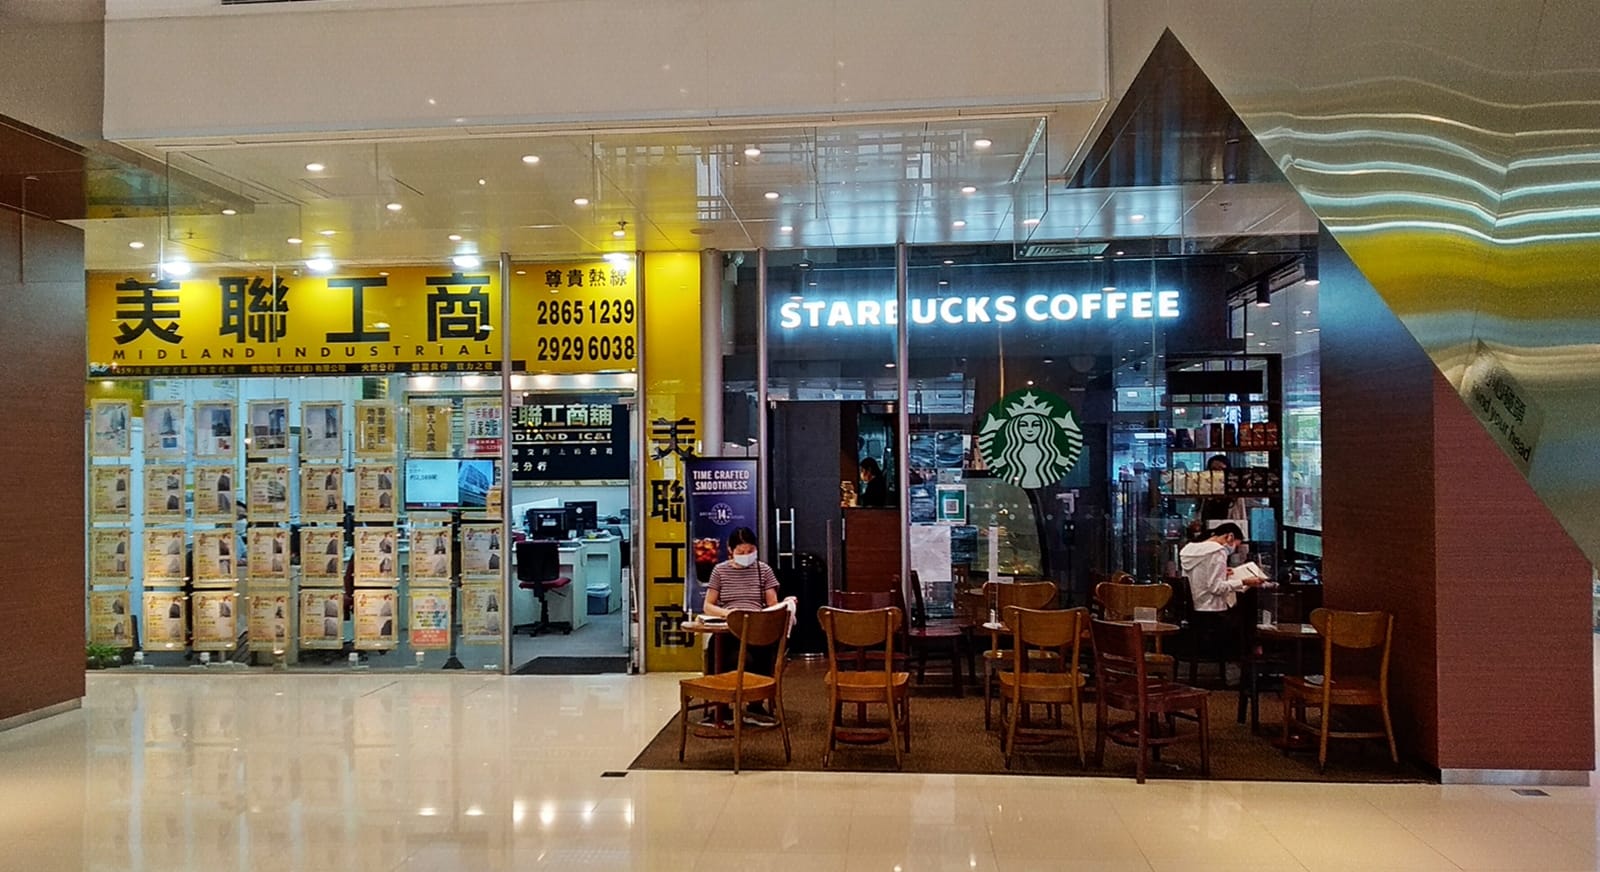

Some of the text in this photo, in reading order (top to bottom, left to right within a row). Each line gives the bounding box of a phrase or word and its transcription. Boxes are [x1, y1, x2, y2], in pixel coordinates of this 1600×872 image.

[545, 268, 627, 287] 尊貴熱線
[113, 272, 491, 345] 美聯工商
[537, 298, 634, 325] 2865 1239
[780, 290, 1181, 329] STARBUCKS COFFEE
[113, 344, 492, 360] MIDLAND INDUSTRIAL
[537, 335, 635, 361] 2929 6038
[579, 432, 611, 440] IC&I
[692, 470, 750, 480] TIME CRAFTED
[695, 480, 748, 491] SMOOTHNESS
[717, 508, 727, 520] 14
[651, 417, 697, 648] 美聯工商
